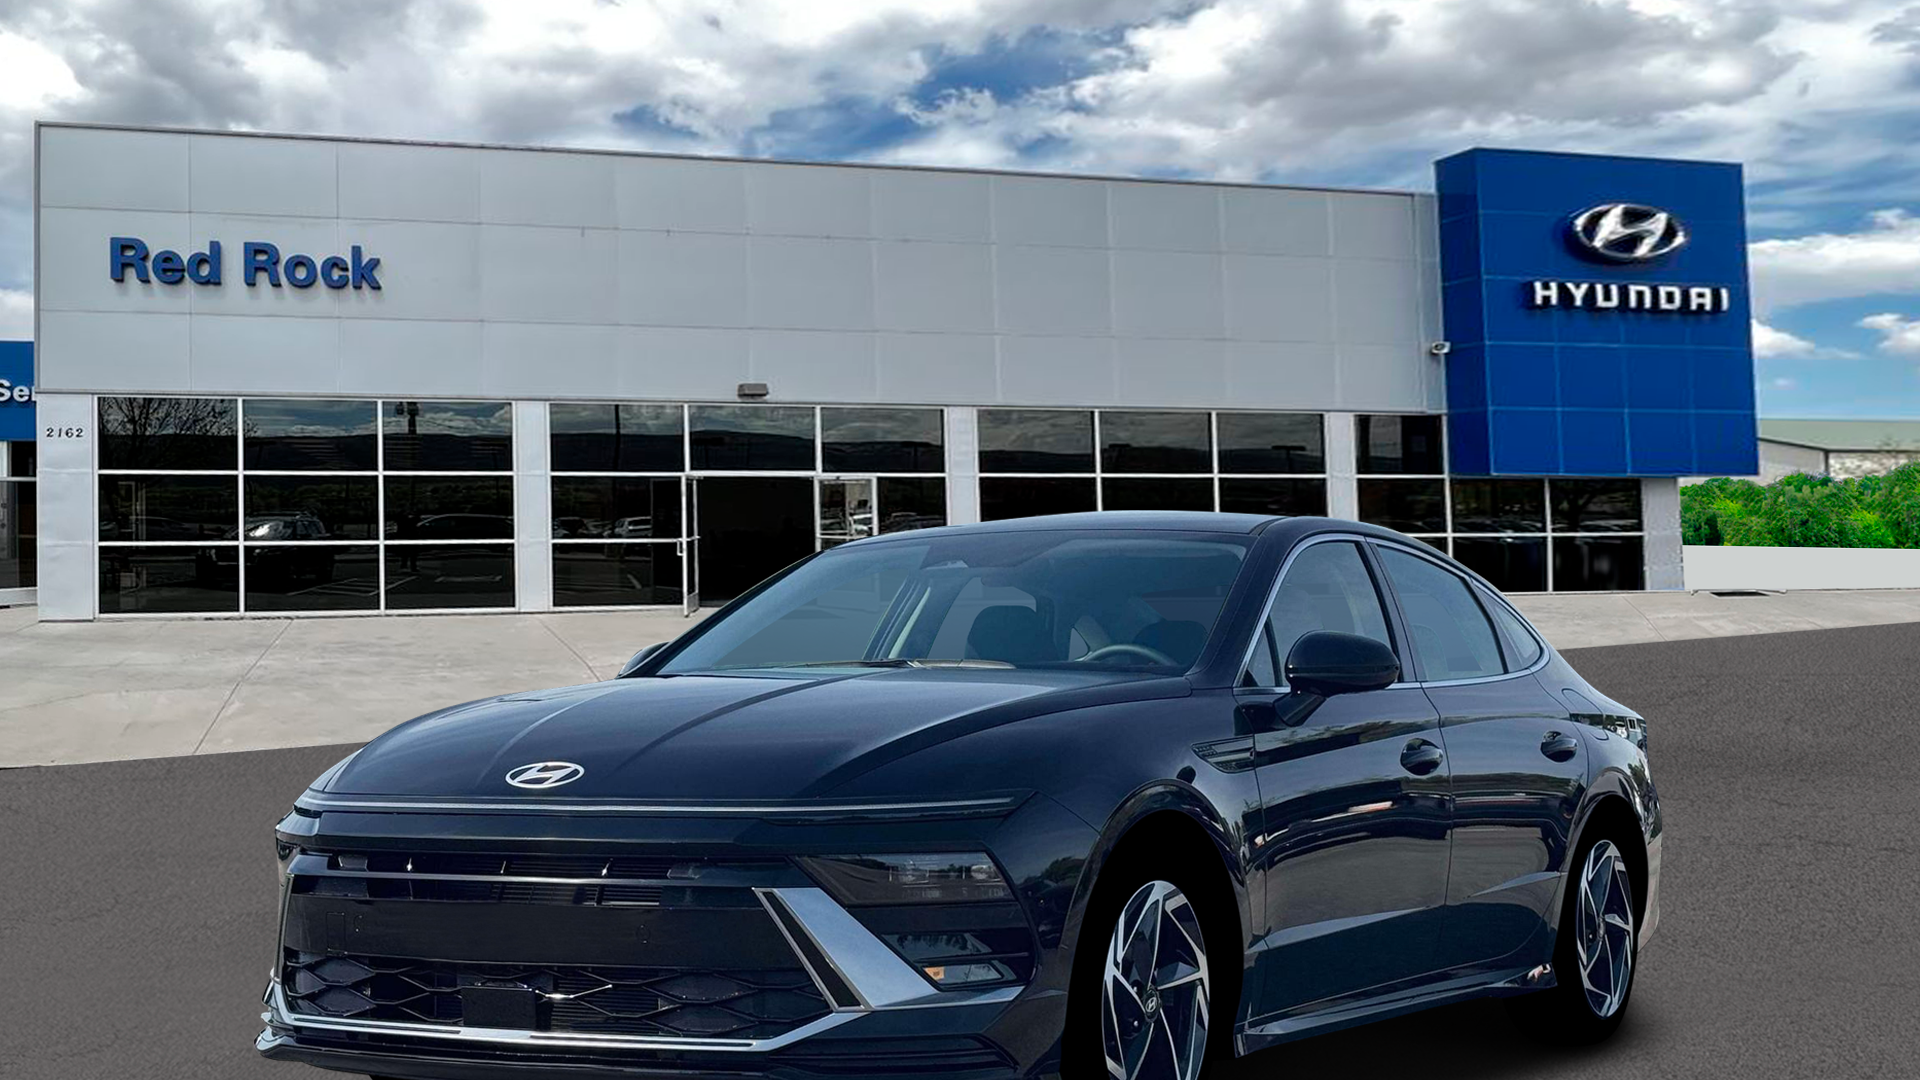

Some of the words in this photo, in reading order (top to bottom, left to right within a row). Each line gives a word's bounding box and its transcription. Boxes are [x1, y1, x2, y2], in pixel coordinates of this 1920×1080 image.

[110, 236, 222, 285] Red
[243, 241, 382, 290] Rock
[1533, 280, 1729, 312] HYUNDAI
[46, 427, 84, 438] 2162
